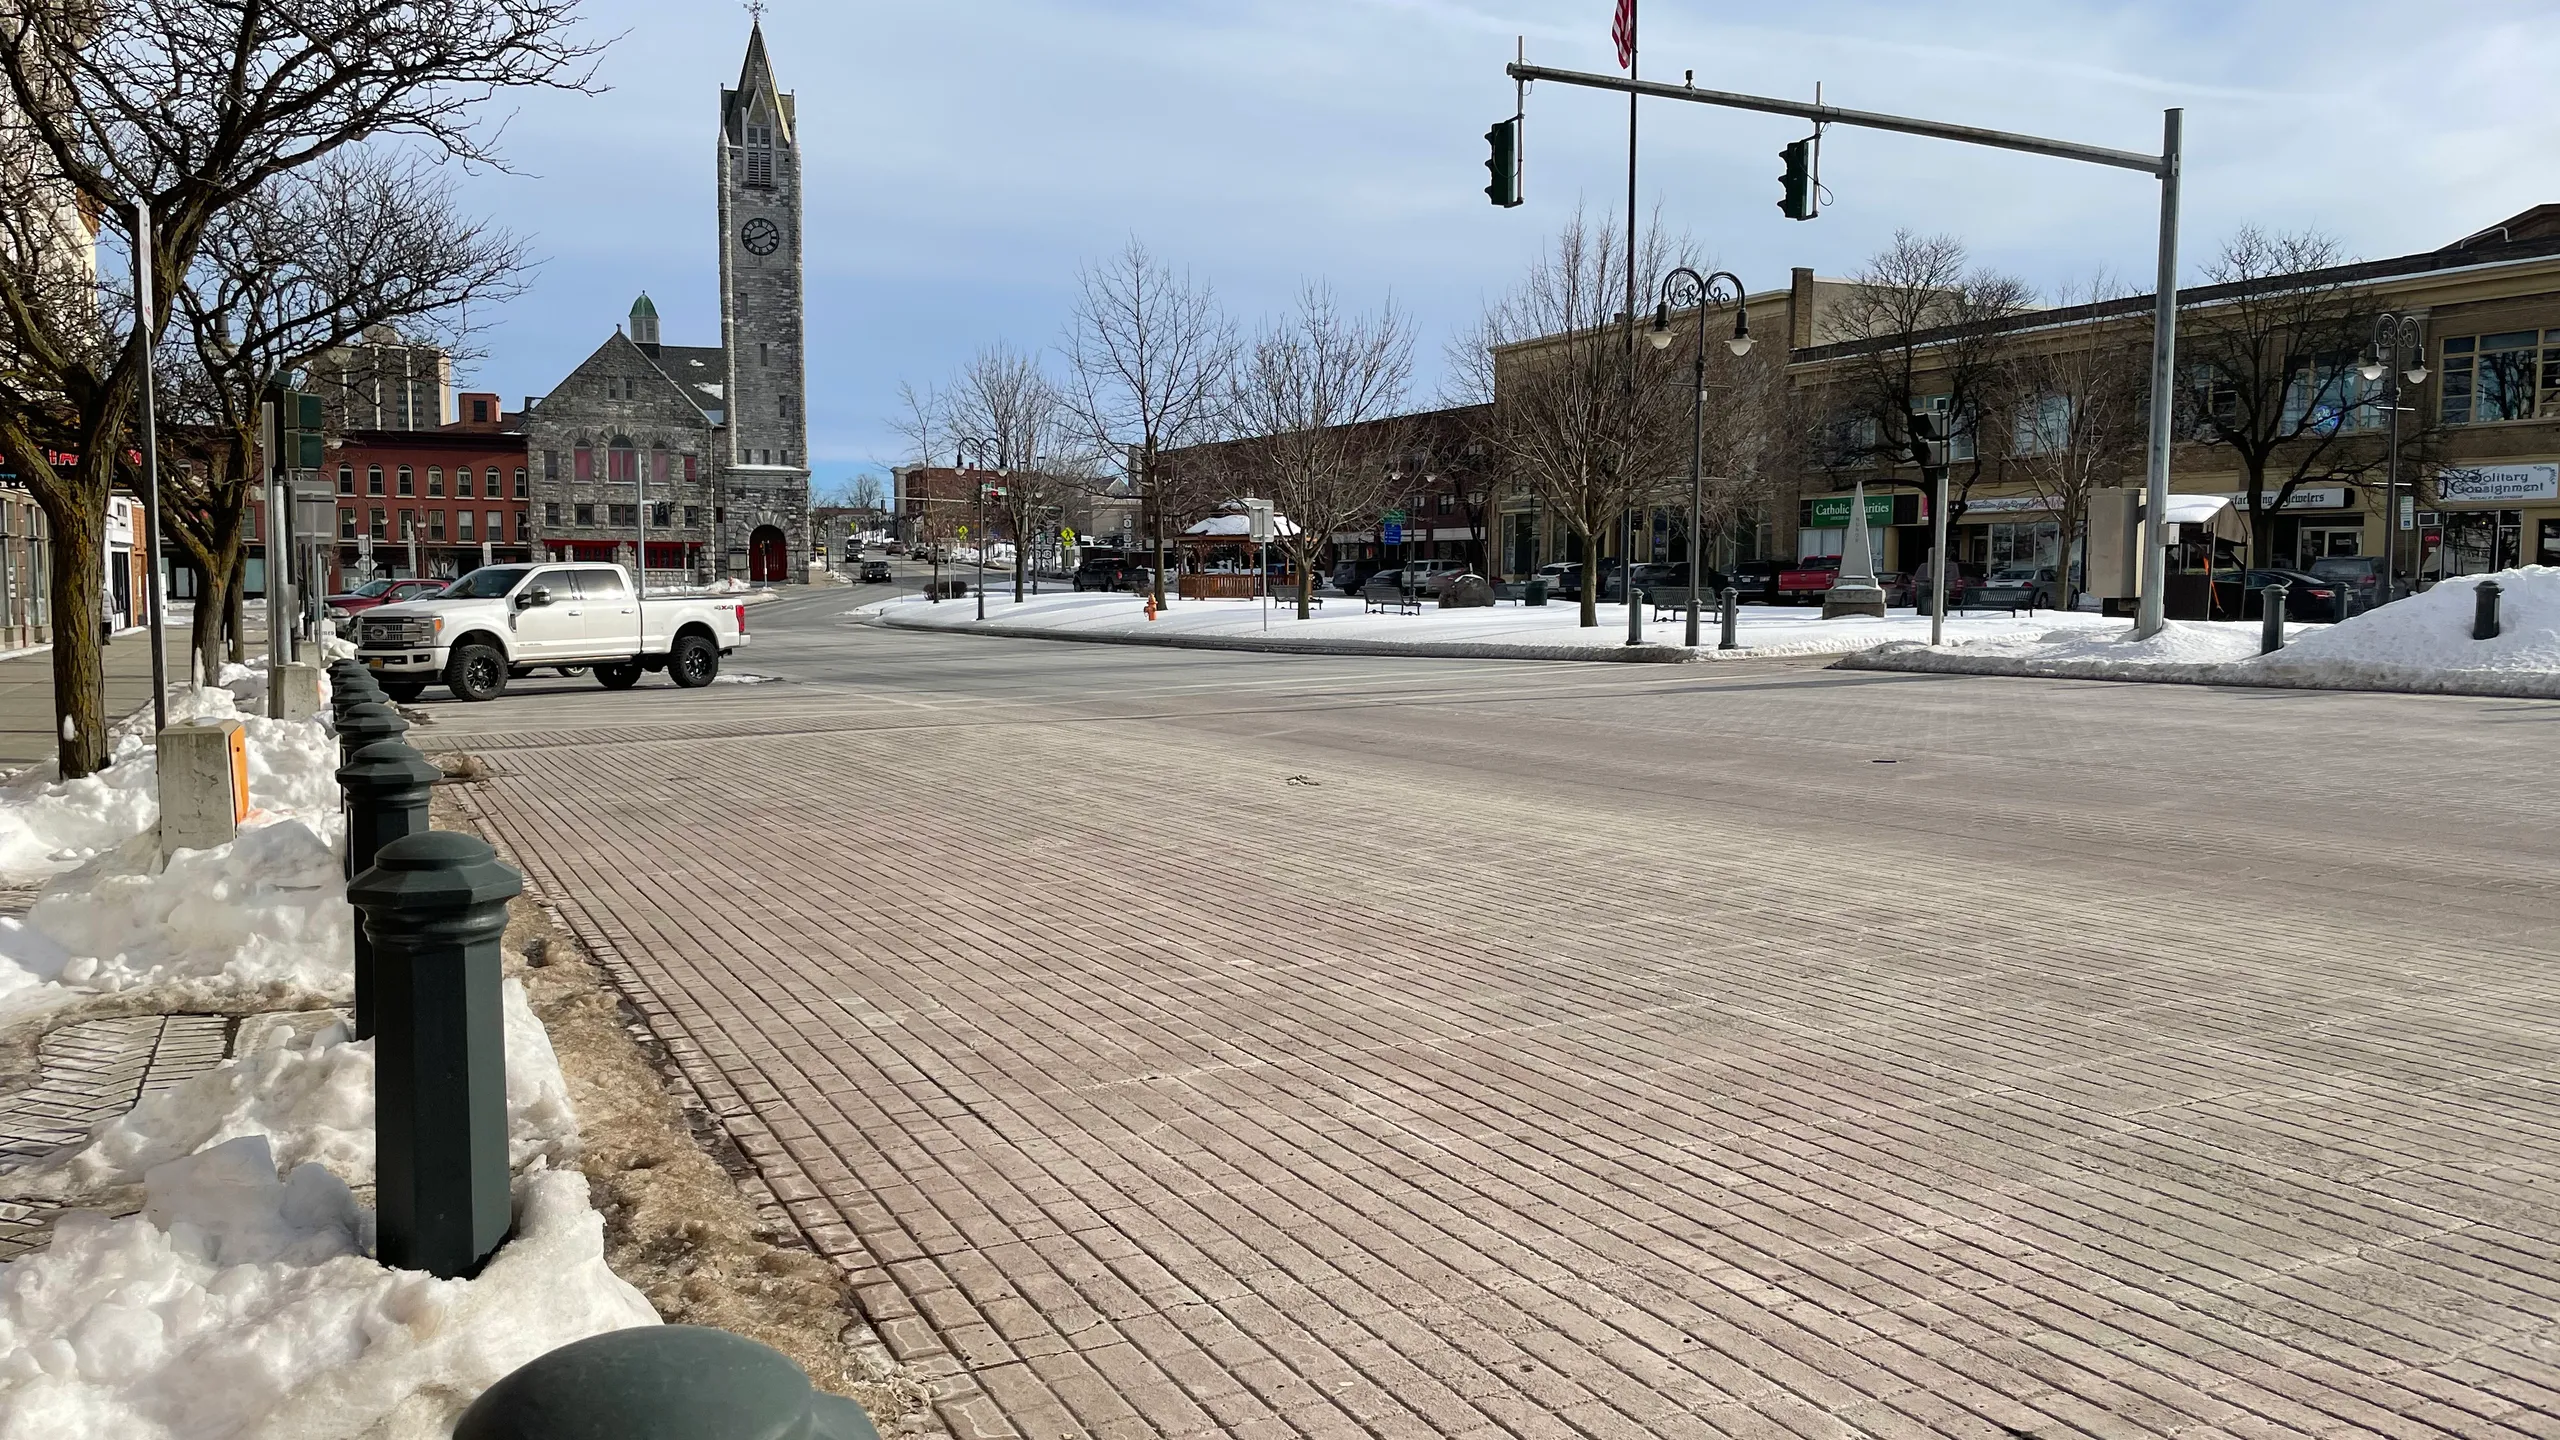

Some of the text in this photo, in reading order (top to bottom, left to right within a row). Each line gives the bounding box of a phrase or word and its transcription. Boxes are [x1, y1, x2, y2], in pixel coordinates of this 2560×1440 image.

[2462, 468, 2529, 484] Solitary
[2451, 480, 2544, 496] Consignment
[1816, 502, 1889, 515] Catholic arities
